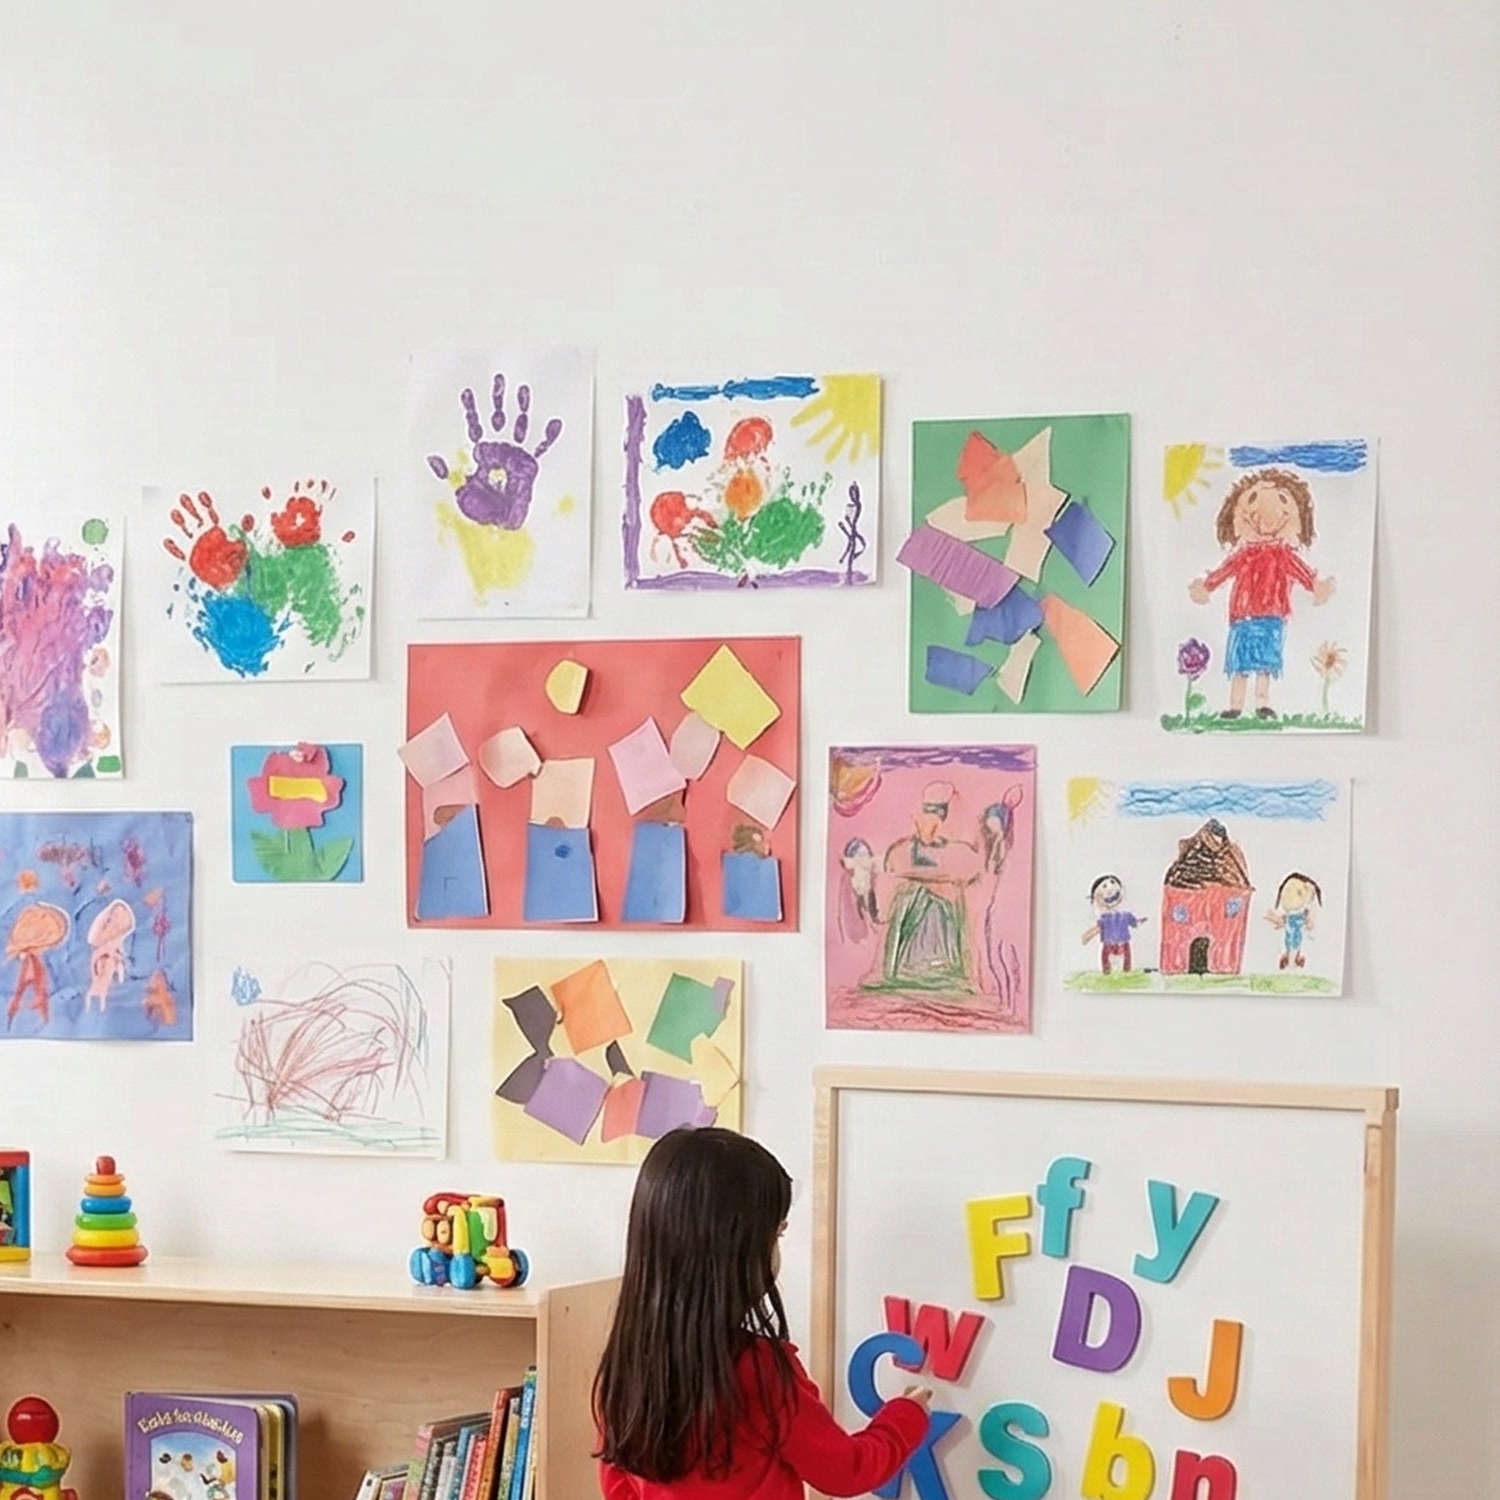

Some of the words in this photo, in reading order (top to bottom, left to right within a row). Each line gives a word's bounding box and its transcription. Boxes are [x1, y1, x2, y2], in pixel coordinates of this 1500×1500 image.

[967, 1195, 1032, 1300] F
[1037, 1156, 1091, 1258] f
[1133, 1179, 1220, 1284] y
[1053, 1265, 1142, 1373] D
[1168, 1318, 1244, 1421] J
